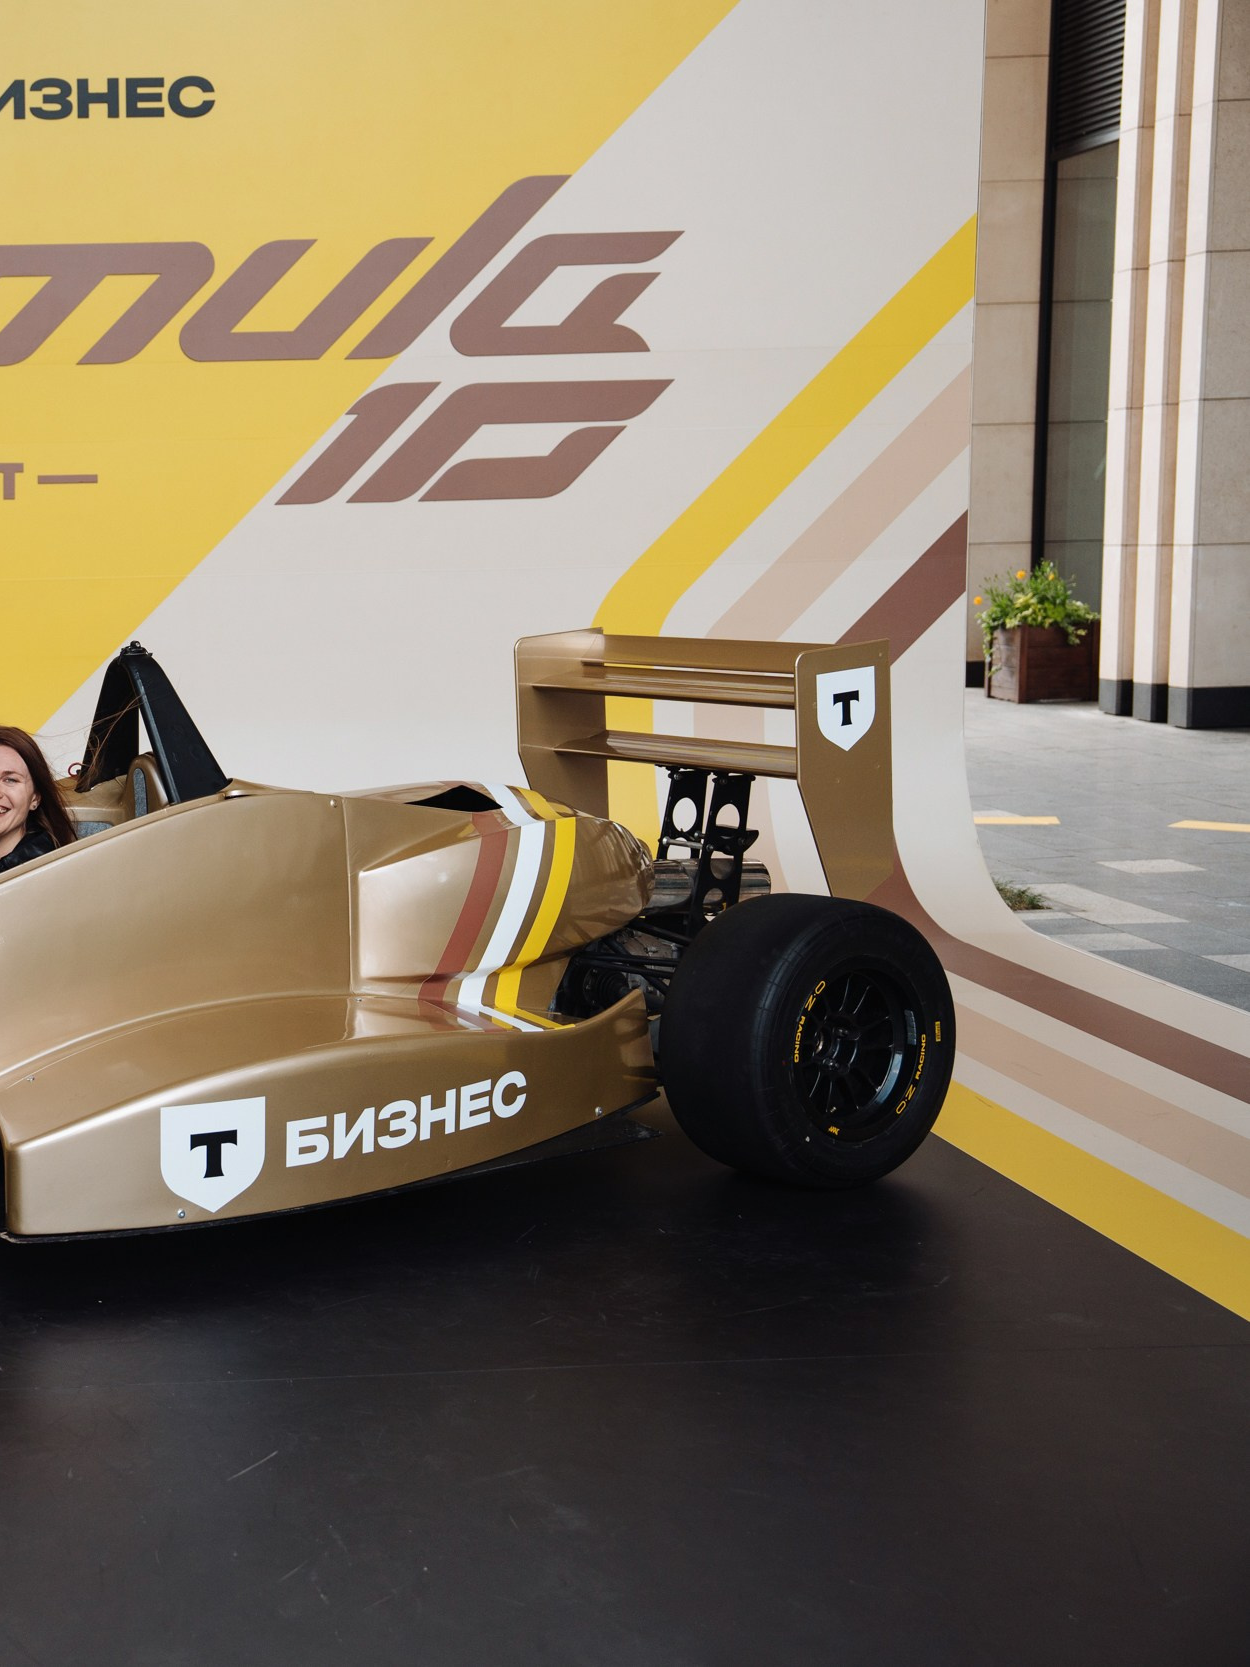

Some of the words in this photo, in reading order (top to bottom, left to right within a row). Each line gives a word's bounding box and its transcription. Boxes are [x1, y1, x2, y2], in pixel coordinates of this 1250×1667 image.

[793, 1015, 806, 1063] RACING
[915, 1033, 927, 1080] RACING
[285, 1071, 528, 1168] БИЗНЕС
